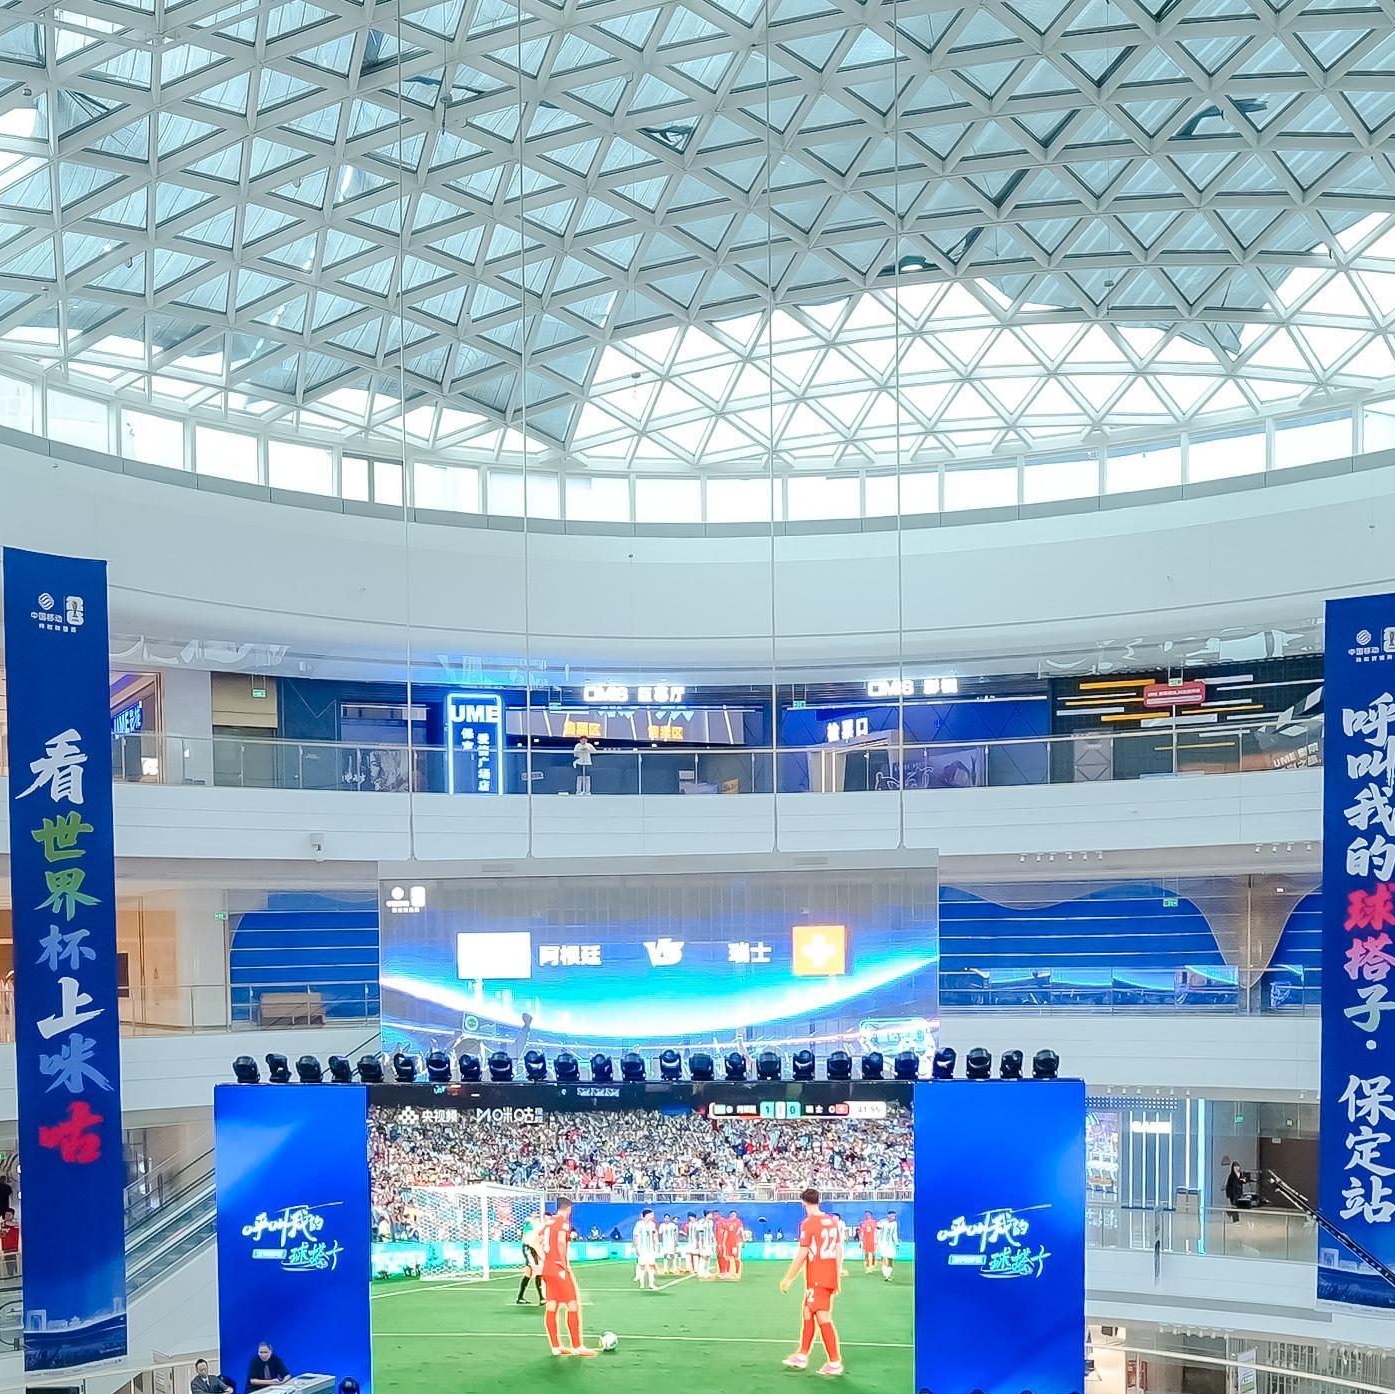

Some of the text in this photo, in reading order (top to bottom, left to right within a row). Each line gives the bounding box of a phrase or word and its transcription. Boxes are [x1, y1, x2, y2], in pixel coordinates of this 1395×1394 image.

[450, 704, 499, 723] UME
[1273, 751, 1296, 768] UME
[15, 727, 114, 1166] 看世界杯上咪咕
[539, 937, 772, 967] 阿根廷 VS 瑞士
[421, 1108, 458, 1123] 央视频
[820, 1227, 838, 1259] 22
